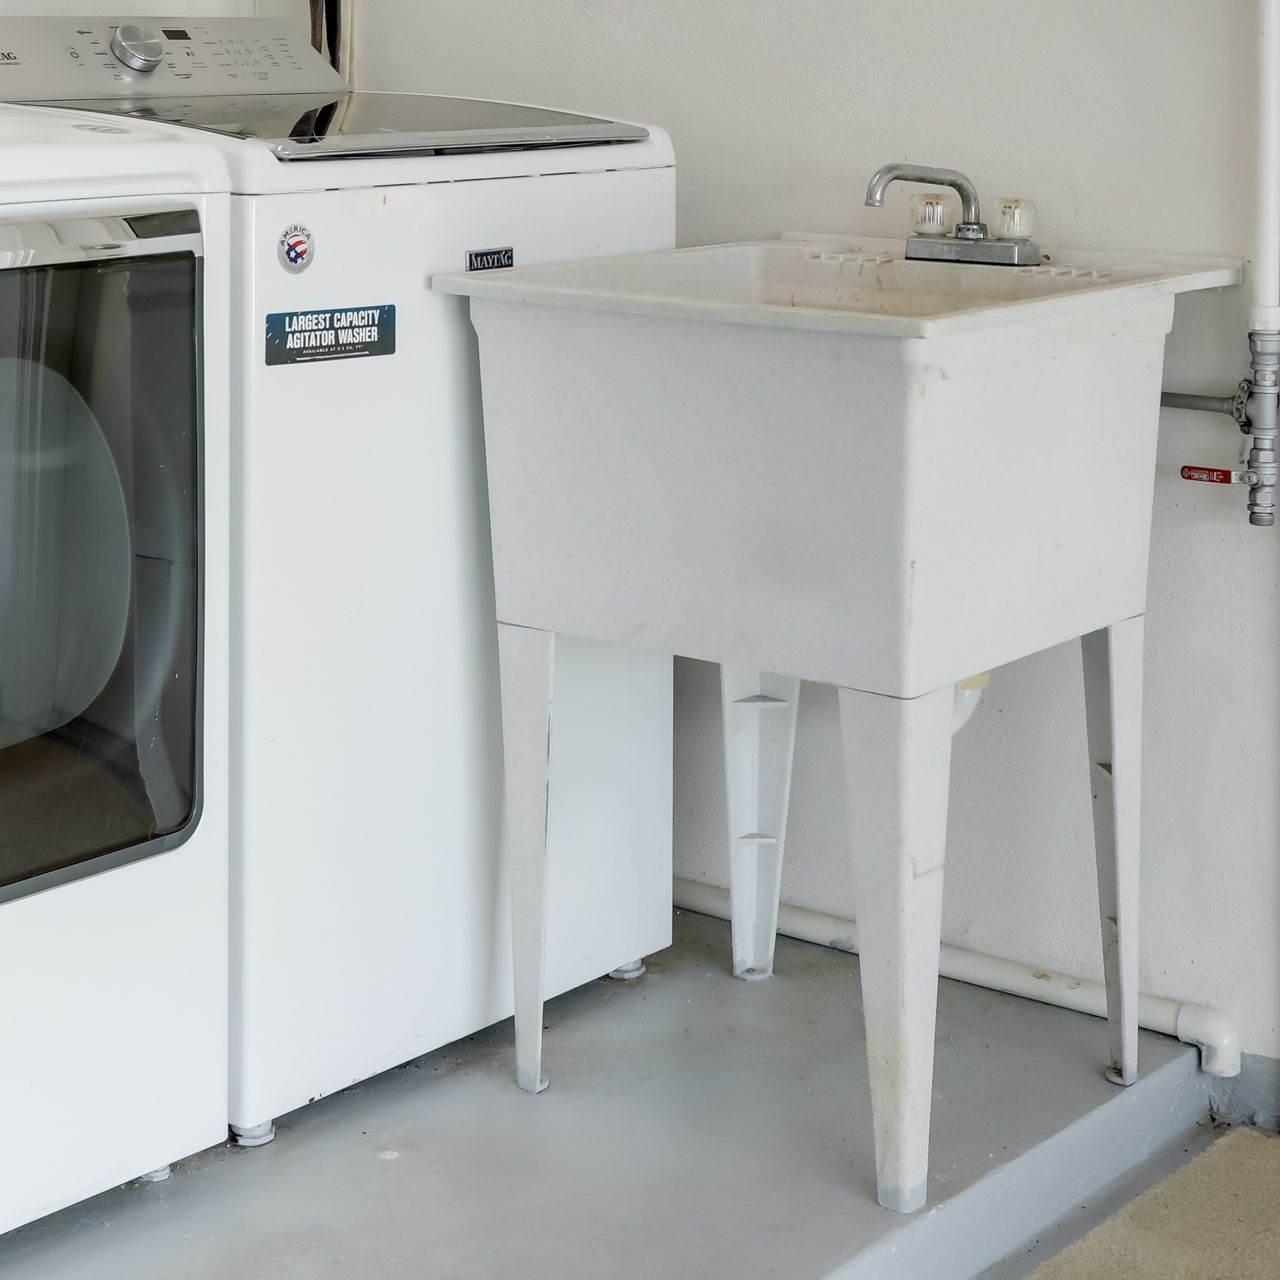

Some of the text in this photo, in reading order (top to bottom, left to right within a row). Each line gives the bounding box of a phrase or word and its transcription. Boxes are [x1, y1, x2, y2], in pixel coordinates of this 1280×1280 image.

[280, 225, 311, 247] AMERICA
[471, 250, 512, 270] MAYTAG
[285, 309, 380, 332] LARGEST CAPACITY
[286, 326, 378, 349] AGITATOR WASHER
